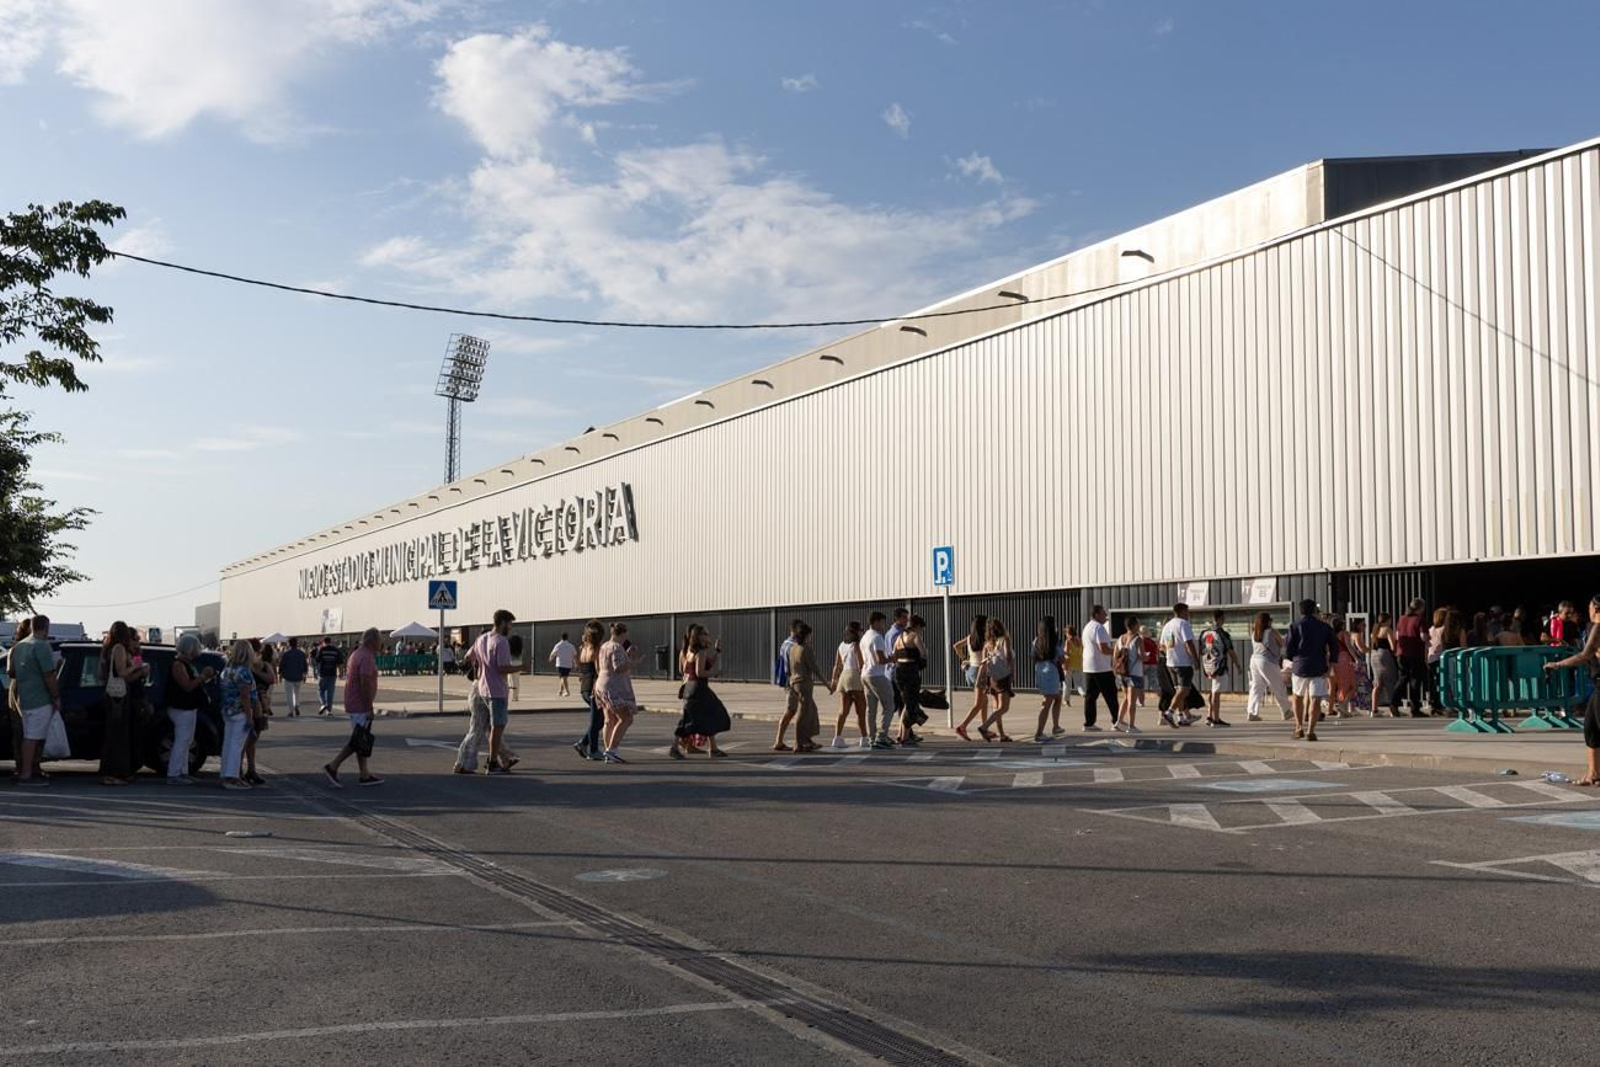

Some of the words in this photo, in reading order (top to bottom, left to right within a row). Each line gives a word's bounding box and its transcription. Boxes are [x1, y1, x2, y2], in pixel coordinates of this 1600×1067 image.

[298, 563, 325, 599] NUEVO
[326, 551, 371, 595] ESTADIO
[373, 531, 448, 586] MUNICIPAL
[450, 524, 478, 573] DE
[480, 515, 506, 568] LA
[511, 482, 634, 560] VICTORIA
[936, 551, 949, 583] P
